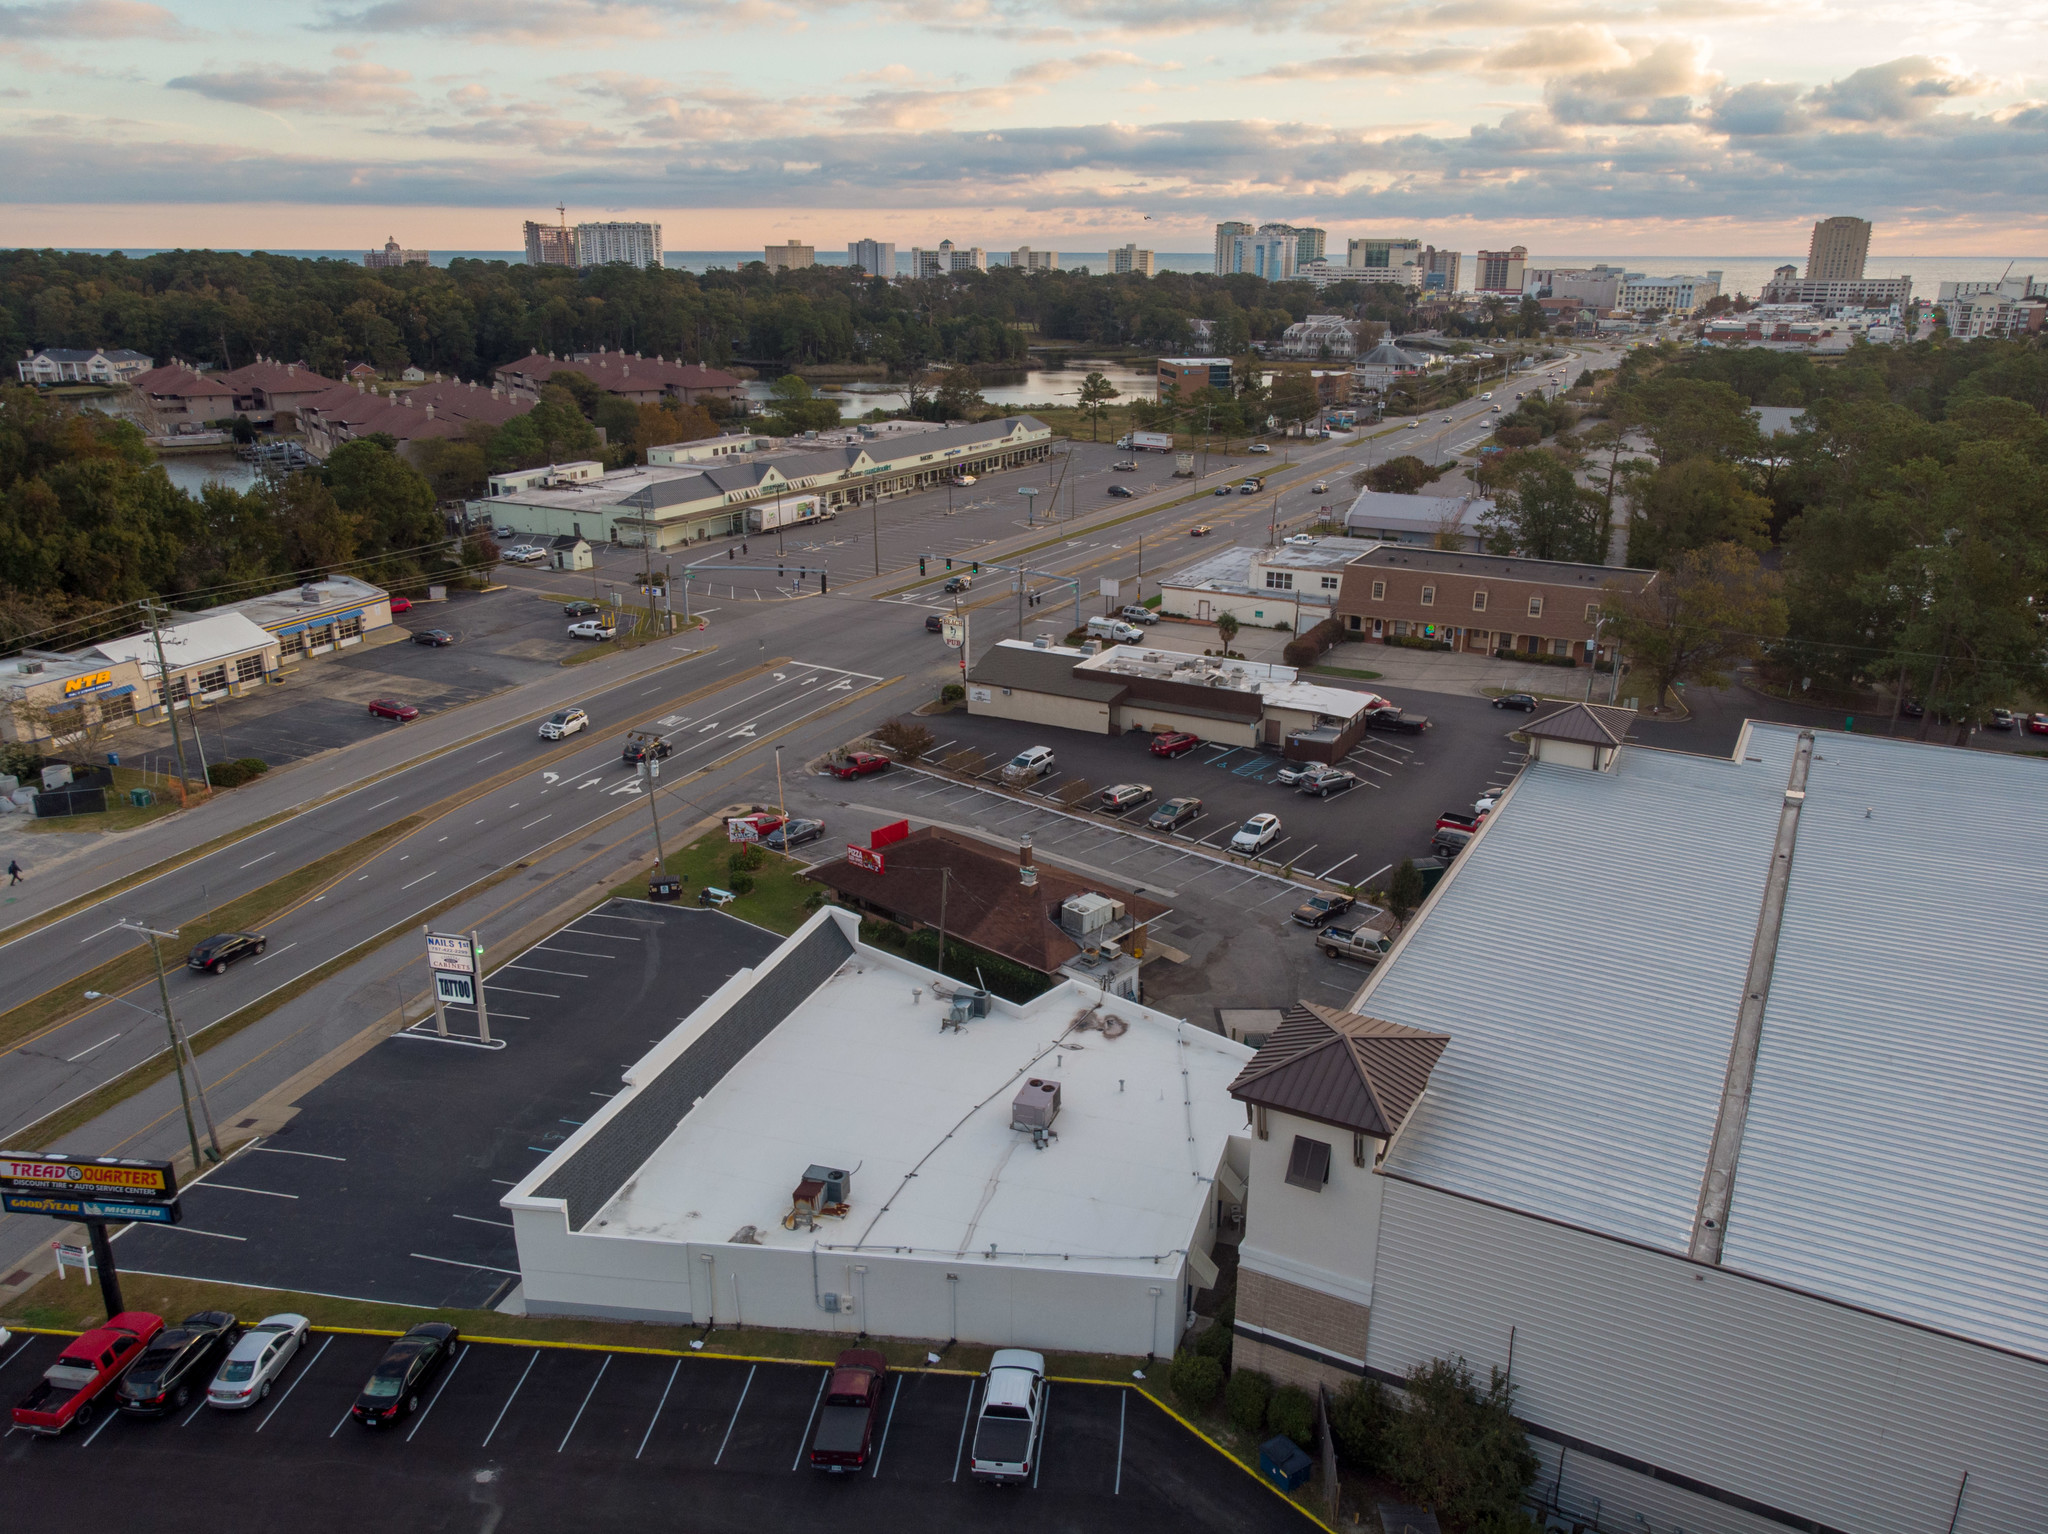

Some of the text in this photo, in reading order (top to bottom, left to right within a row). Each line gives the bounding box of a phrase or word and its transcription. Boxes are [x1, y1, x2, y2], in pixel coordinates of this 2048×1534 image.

[943, 618, 963, 627] BEACH
[946, 638, 961, 647] PUB
[65, 671, 111, 693] NTB
[428, 938, 454, 947] NAILS
[433, 961, 470, 970] CABINETS
[438, 978, 471, 998] TATTOO
[10, 1163, 66, 1179] TREAD
[84, 1167, 158, 1186] QUARTERS
[13, 1179, 157, 1196] DISCOUNT TIRE AUTO SERVICE CENTERS
[11, 1199, 161, 1217] GOODYEAR MICHELIN
